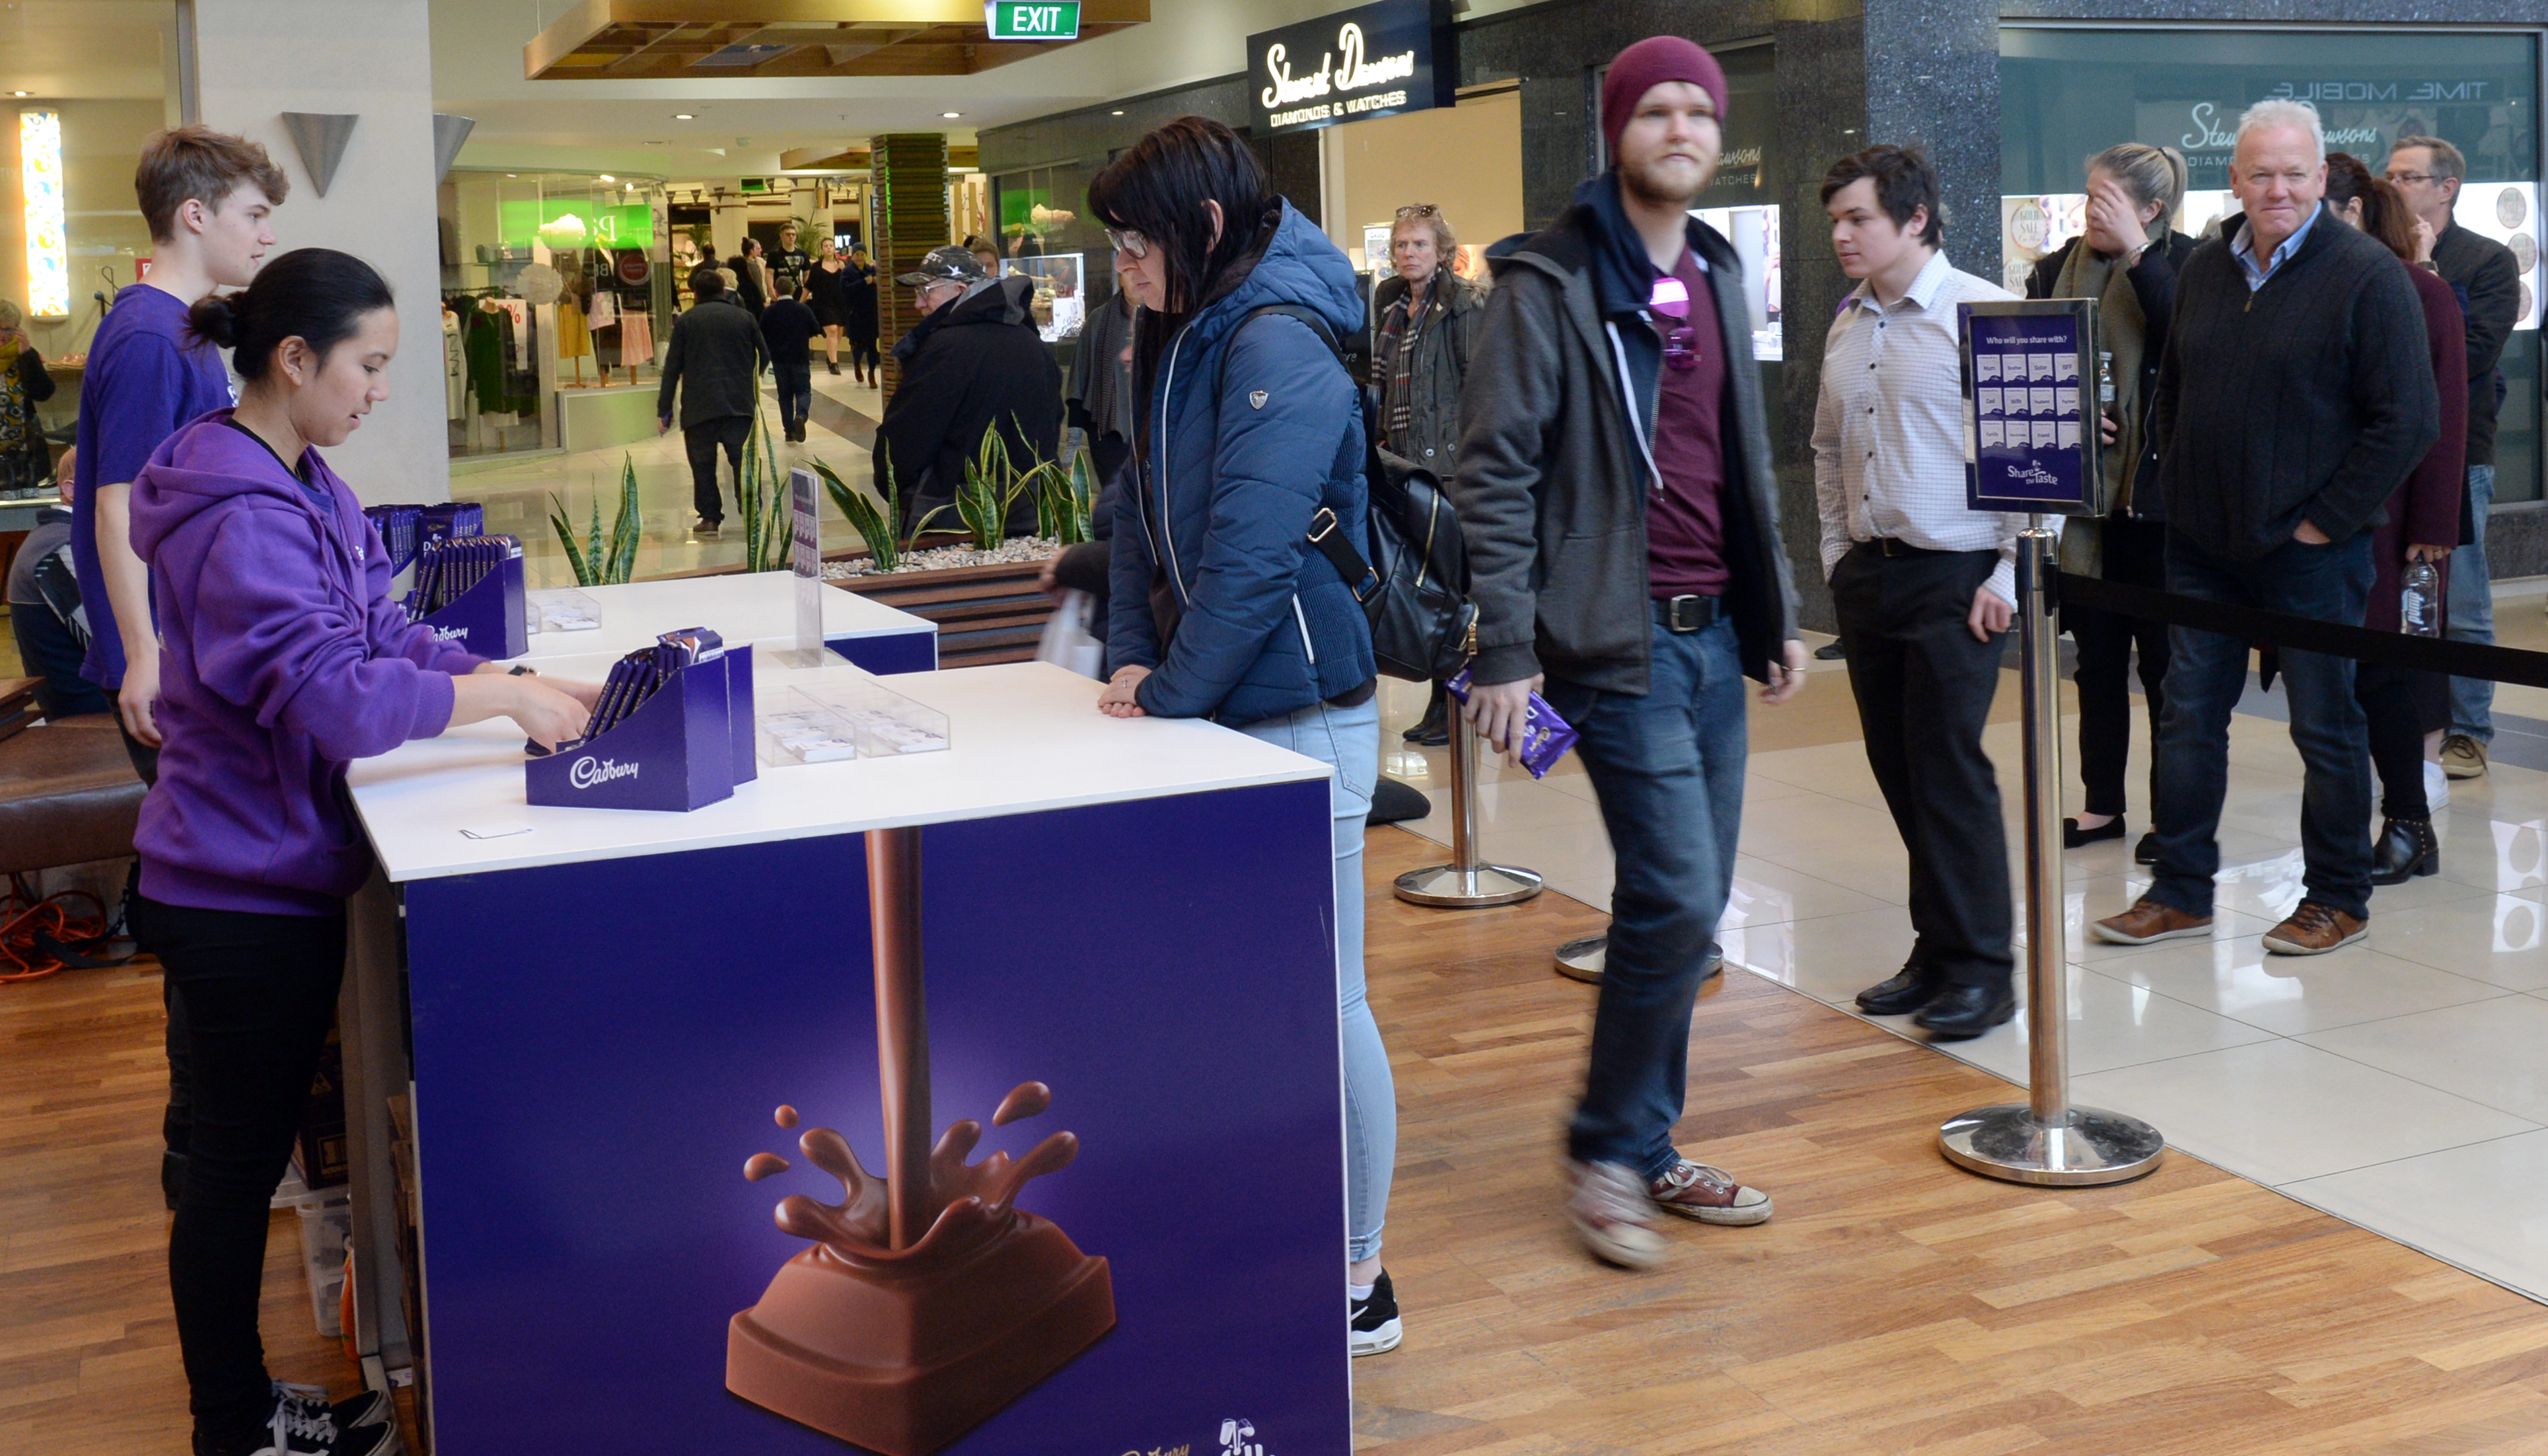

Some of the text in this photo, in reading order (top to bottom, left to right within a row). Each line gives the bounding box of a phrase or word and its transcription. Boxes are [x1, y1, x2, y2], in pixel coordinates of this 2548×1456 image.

[1013, 6, 1062, 32] EXIT
[1270, 90, 1406, 127] DIAMONDS & WATCHES
[2187, 156, 2235, 166] DIAM
[2020, 222, 2038, 234] SALE
[2008, 465, 2035, 478] Share
[2034, 471, 2058, 485] Taste
[2408, 591, 2424, 625] pump
[427, 625, 468, 642] adbury
[593, 682, 611, 717] CHOCOLATE
[604, 681, 622, 717] CHOCOLATE
[616, 682, 634, 719] CHOCOLATE
[570, 756, 639, 789] Cadbury
